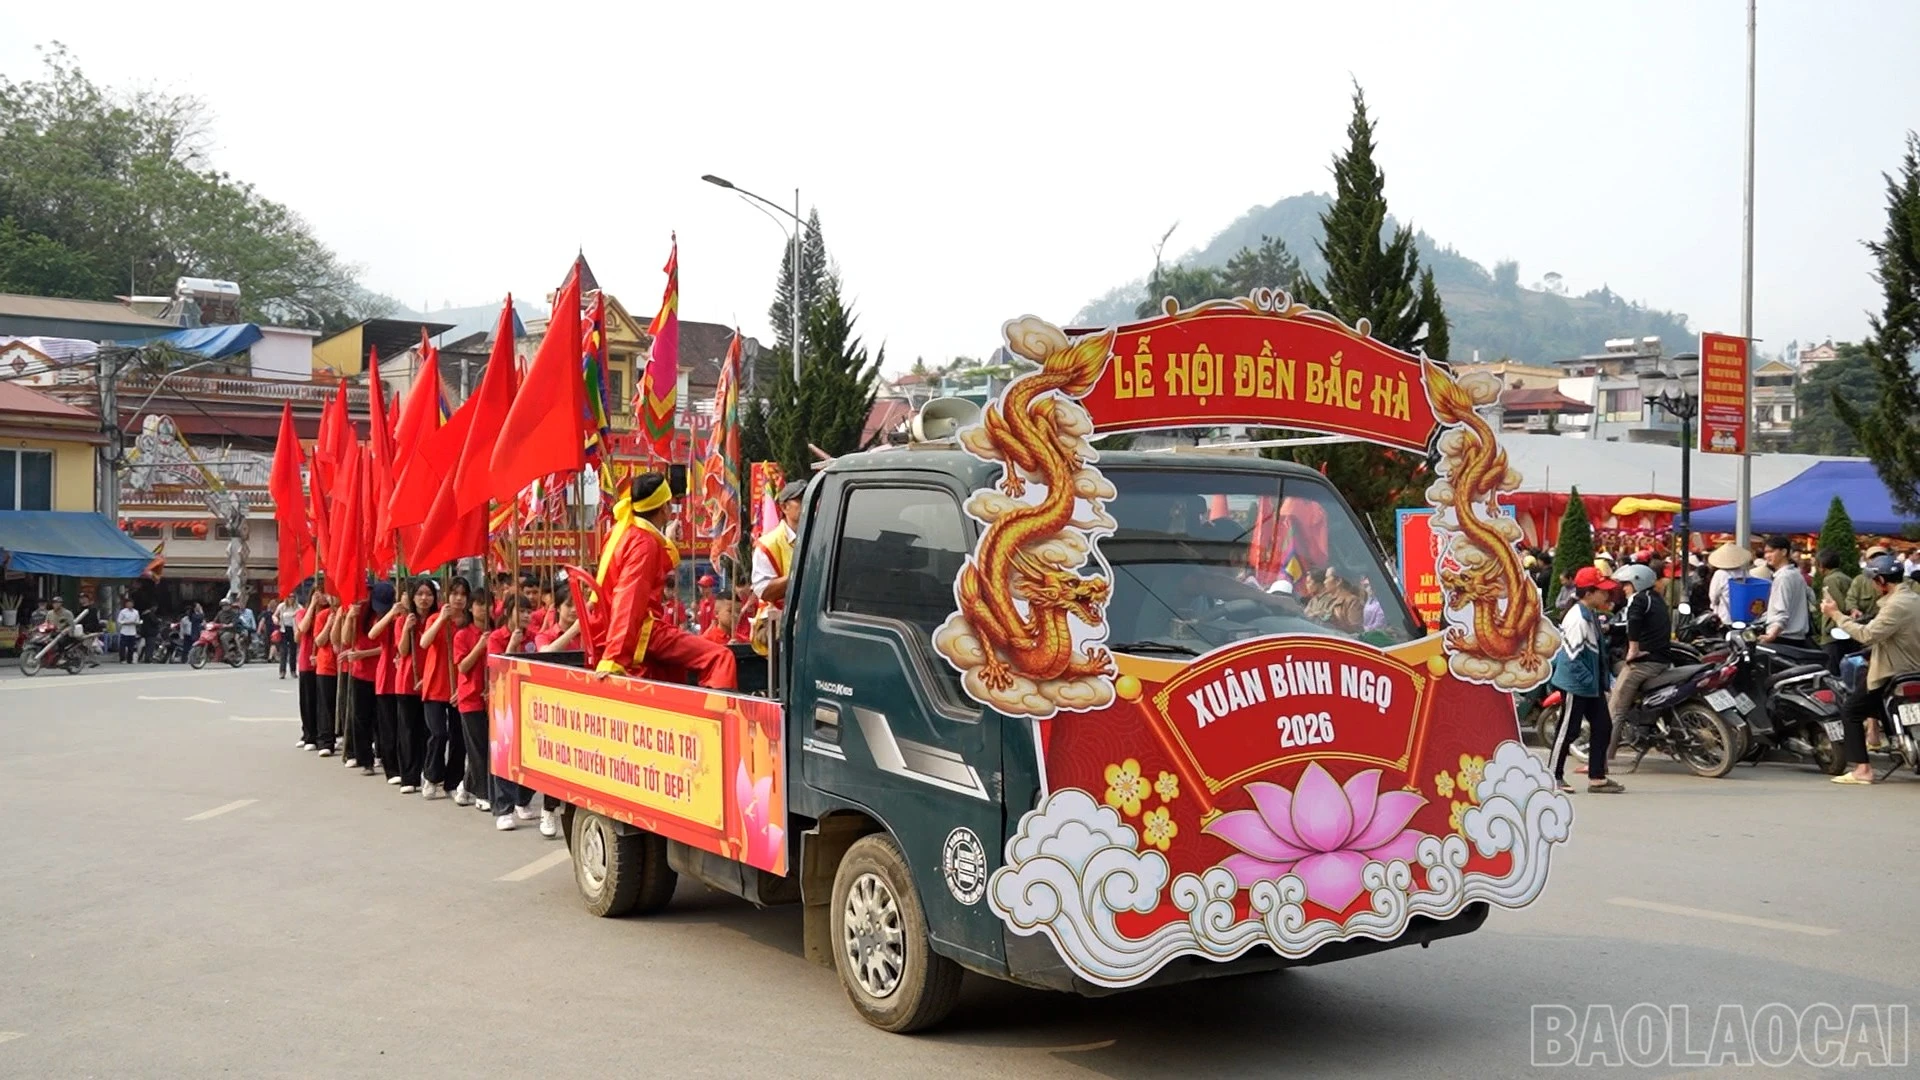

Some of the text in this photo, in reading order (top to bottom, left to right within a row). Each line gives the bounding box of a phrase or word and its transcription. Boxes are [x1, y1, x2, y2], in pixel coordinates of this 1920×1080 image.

[1113, 335, 1411, 422] LỄ HỘI ĐỀN BẮC HÀ
[1186, 655, 1392, 728] XUÂN BÍNH NGỌ
[610, 719, 629, 743] HUY
[633, 722, 652, 750] CÁC
[657, 728, 675, 755] GIÁ
[679, 734, 696, 767] TRỊ
[1277, 712, 1335, 748] 2026
[609, 754, 640, 787] THỐNG
[643, 762, 660, 793] TỐT
[664, 772, 683, 803] ĐẸP
